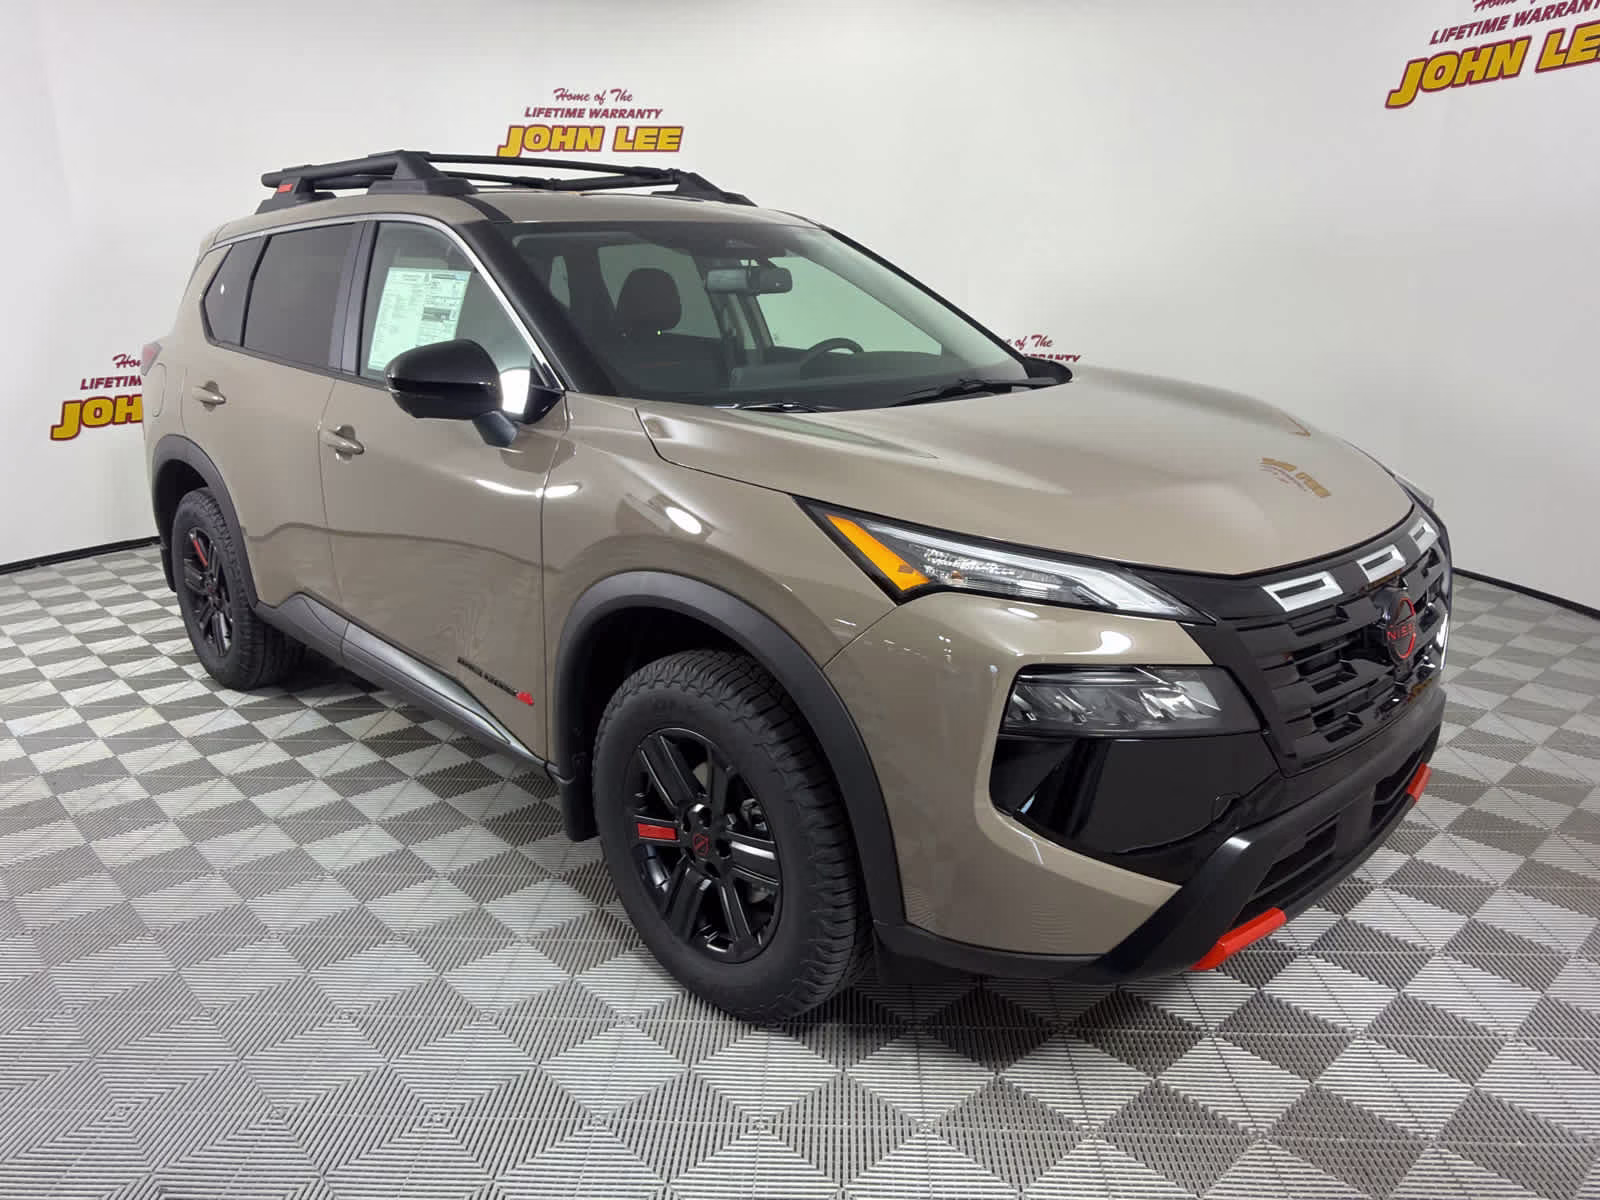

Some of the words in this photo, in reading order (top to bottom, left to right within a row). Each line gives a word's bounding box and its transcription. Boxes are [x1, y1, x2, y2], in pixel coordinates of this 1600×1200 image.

[1430, 15, 1510, 45] LIFETIME
[1385, 36, 1532, 109] JOHN
[1535, 20, 1600, 73] LE
[553, 88, 591, 101] Home
[594, 89, 607, 105] of
[610, 88, 632, 102] The
[524, 107, 586, 119] LIFETIME
[589, 108, 662, 119] WARRANTY
[496, 124, 605, 158] JOHN
[612, 125, 684, 152] LEE
[1015, 336, 1028, 350] of
[1031, 335, 1053, 347] The
[80, 376, 142, 390] LIFETIM
[50, 394, 143, 441] JOH
